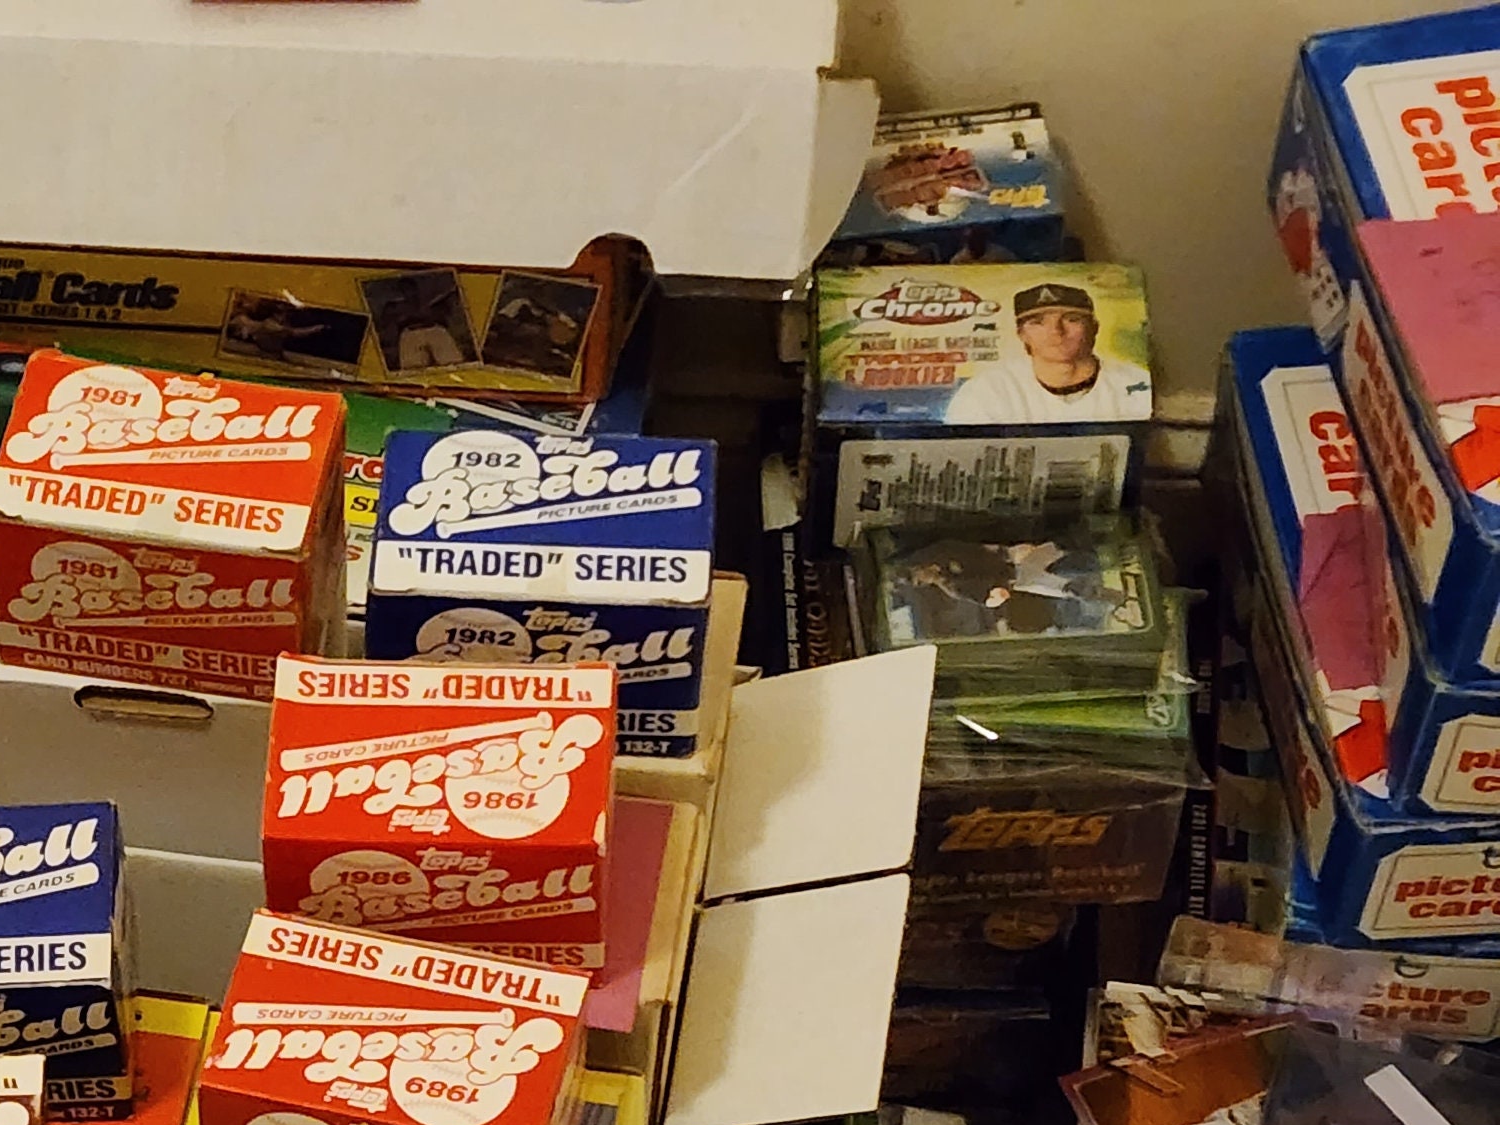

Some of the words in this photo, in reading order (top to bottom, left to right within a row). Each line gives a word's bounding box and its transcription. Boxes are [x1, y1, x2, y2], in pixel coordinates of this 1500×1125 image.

[50, 271, 179, 311] Cards
[860, 299, 1000, 319] Chrome
[79, 385, 143, 408] 1981
[5, 398, 322, 464] Baseball
[149, 449, 224, 460] PICTURE
[228, 447, 290, 458] CARDS
[451, 451, 521, 468] 1982
[8, 474, 166, 517] "TRADED"
[174, 497, 285, 532] SERIES
[388, 450, 702, 536] Baseball
[537, 503, 612, 520] PICTURE
[616, 494, 678, 510] CARDS
[56, 559, 119, 579] 1981
[399, 548, 564, 578] "TRADED"
[575, 554, 688, 583] SERIES
[7, 574, 296, 622] Baseball
[445, 628, 517, 647] 1982
[298, 671, 410, 700] SERIES
[277, 713, 604, 818] Baseball
[463, 790, 539, 810] 1986
[13, 872, 76, 896] CARDS
[336, 870, 412, 887] 1986
[300, 865, 595, 926] Baseball
[266, 927, 384, 970] SERIES
[210, 1017, 564, 1085] Baseball
[404, 1076, 481, 1105] 1989
